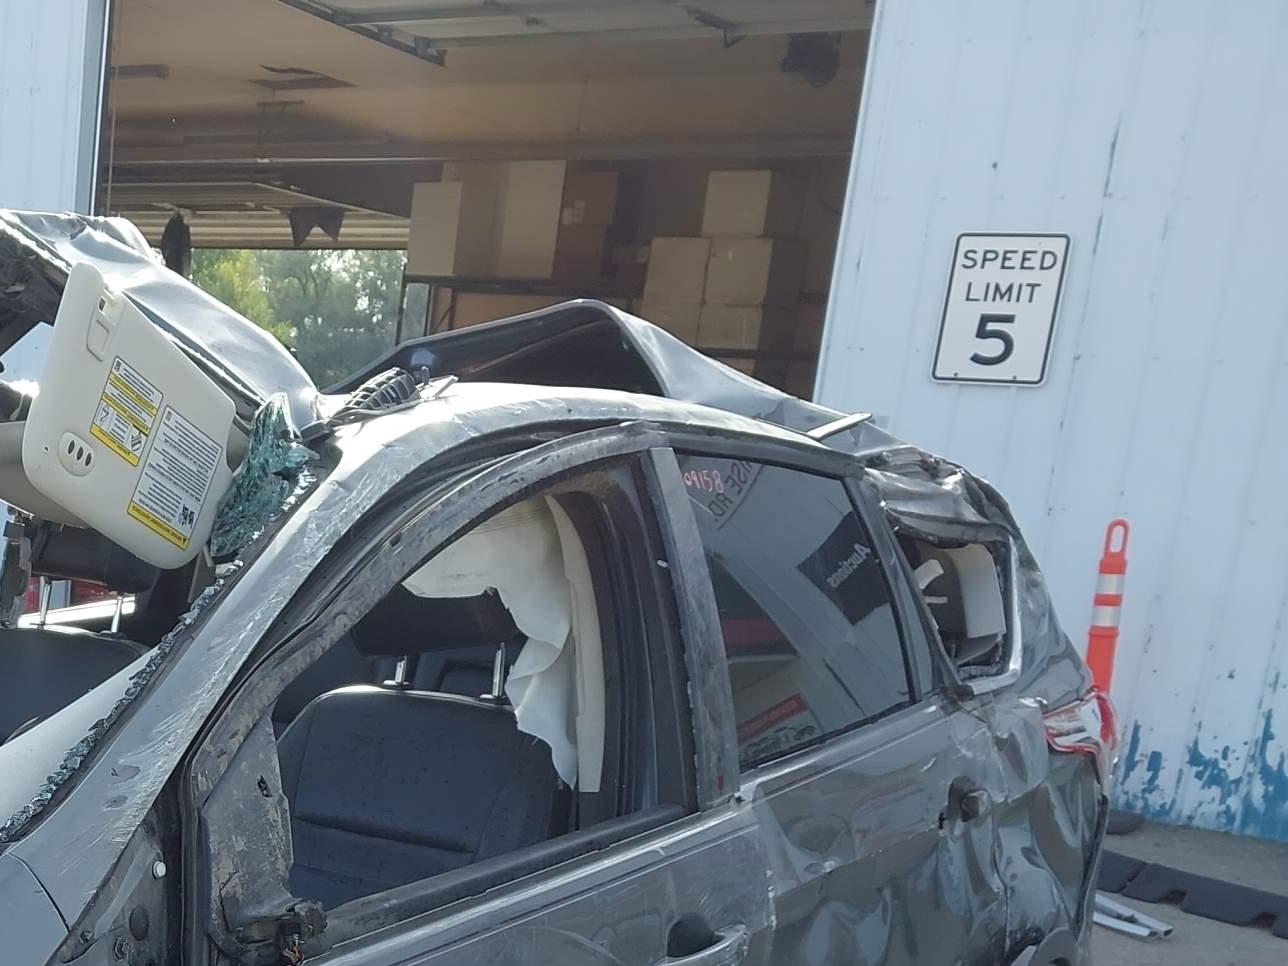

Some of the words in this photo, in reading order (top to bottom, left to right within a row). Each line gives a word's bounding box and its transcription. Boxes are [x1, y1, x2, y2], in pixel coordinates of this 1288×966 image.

[962, 249, 1058, 271] SPEED
[965, 281, 1042, 303] LIMIT
[969, 313, 1016, 366] 5
